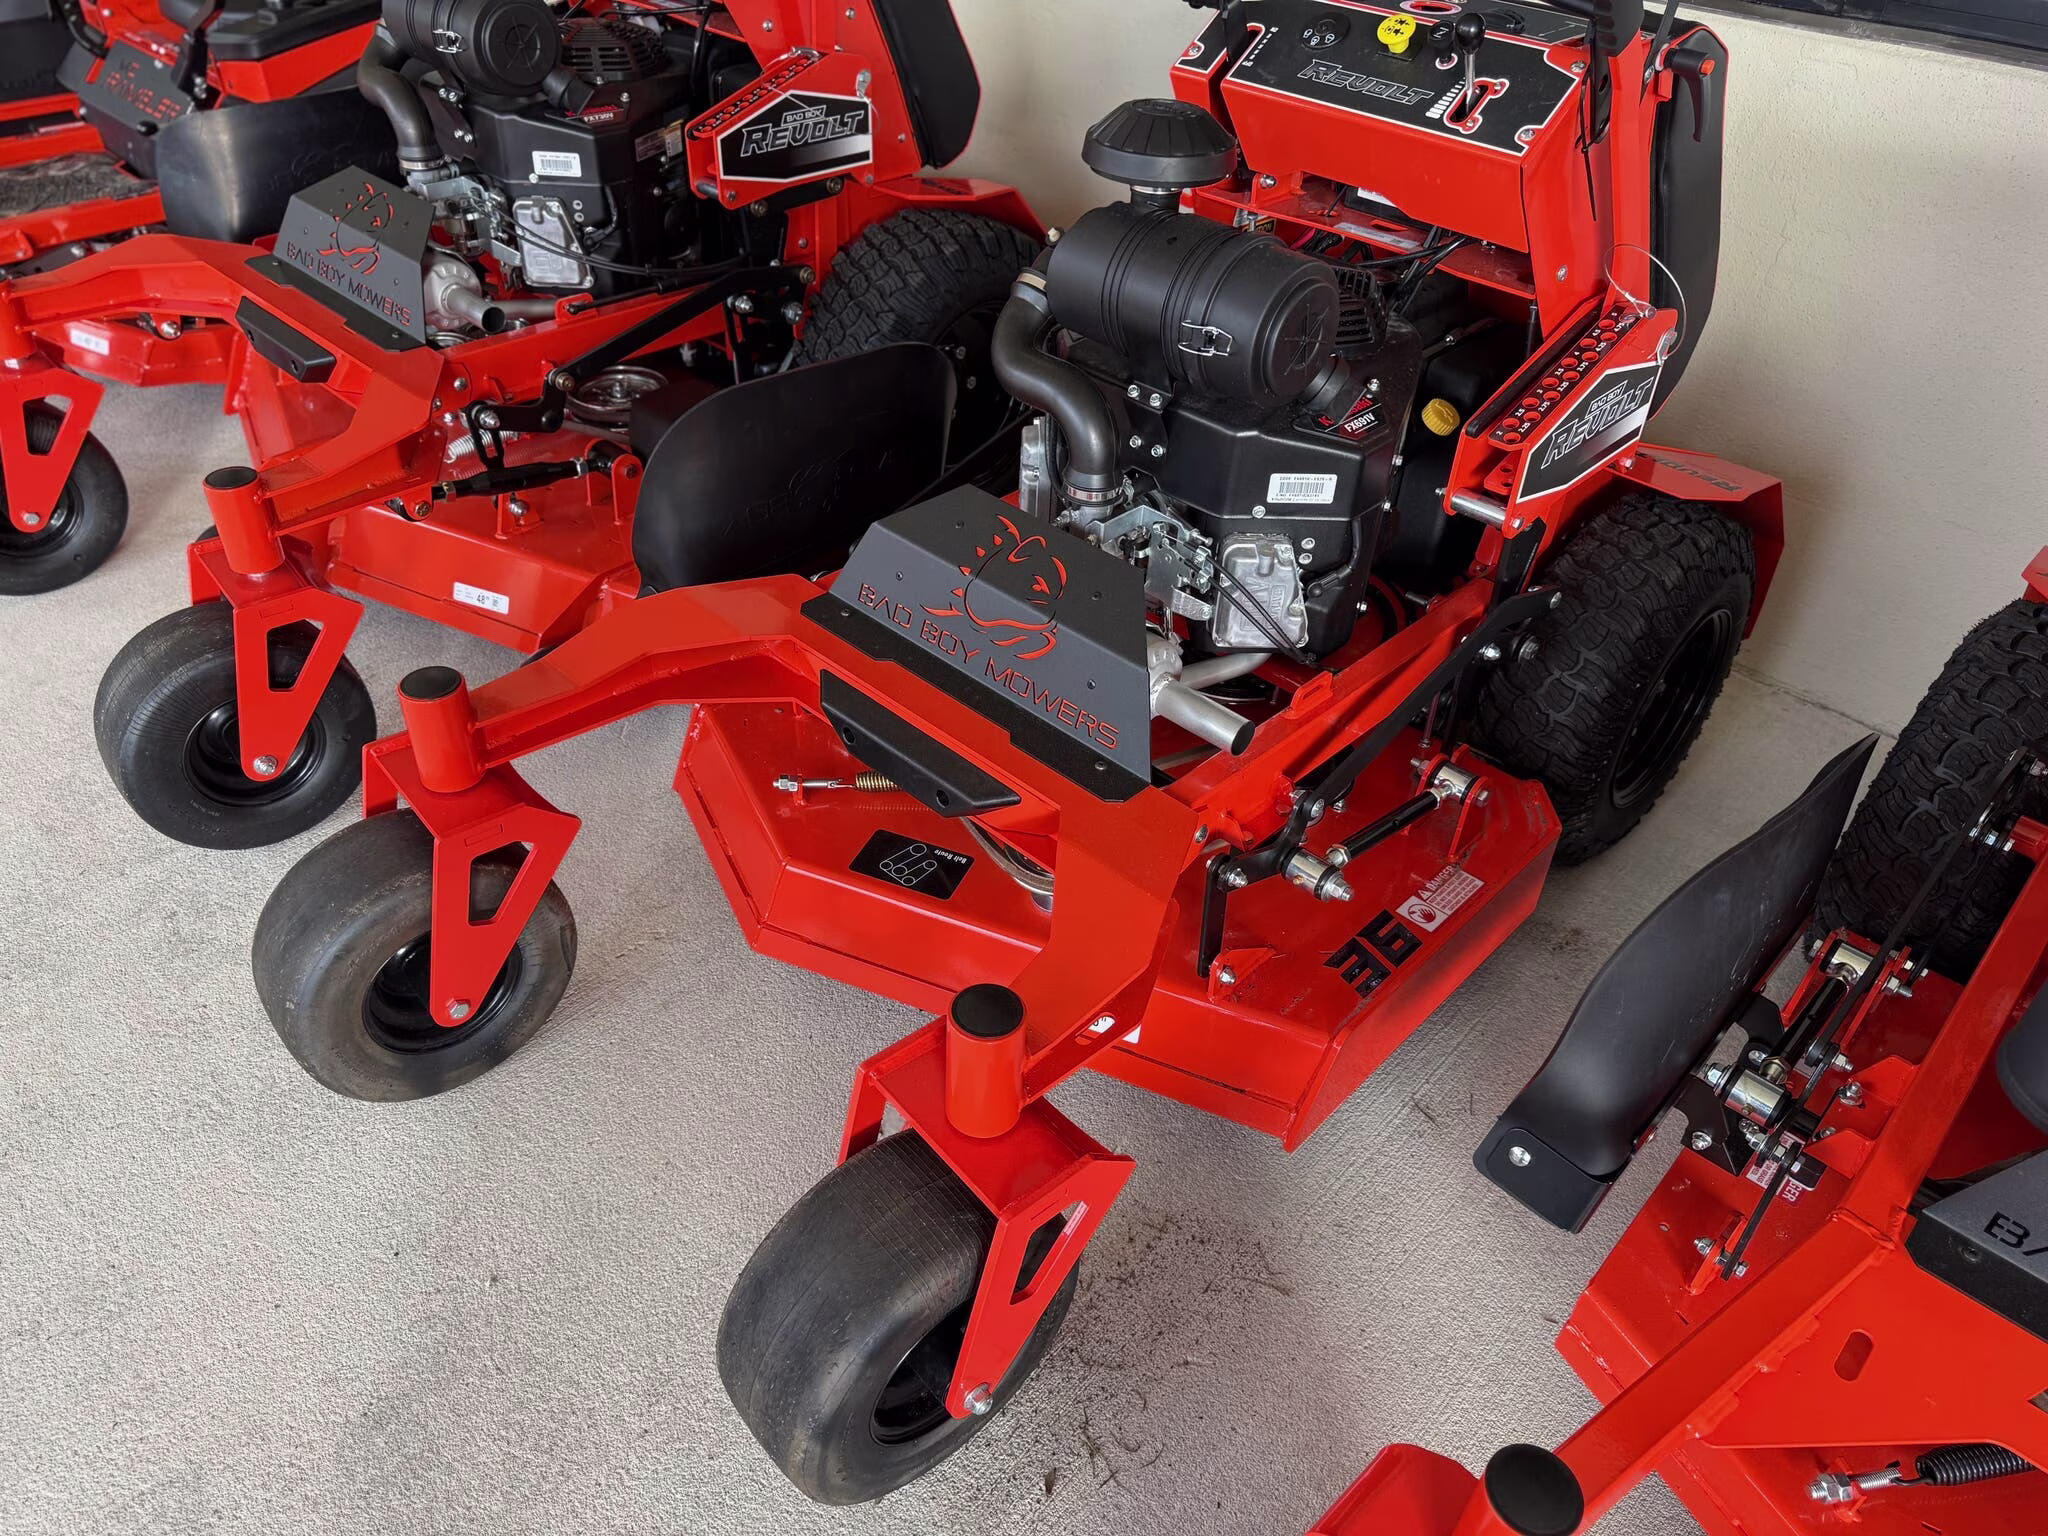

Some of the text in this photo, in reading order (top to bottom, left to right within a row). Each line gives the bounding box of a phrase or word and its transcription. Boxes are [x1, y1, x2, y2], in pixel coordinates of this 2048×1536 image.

[1297, 59, 1435, 105] REVOLT
[740, 110, 865, 158] REVOLT
[786, 111, 804, 123] BAD
[287, 241, 412, 327] BAD BOY MOWERS
[1591, 386, 1622, 412] BAD BOY
[1343, 412, 1376, 433] FX691V
[1540, 376, 1654, 470] REVOLT
[857, 583, 1120, 751] BAD BOY MOWERS
[934, 848, 968, 865] Belt Route
[1425, 865, 1457, 891] DANGER
[1323, 909, 1423, 998] 36
